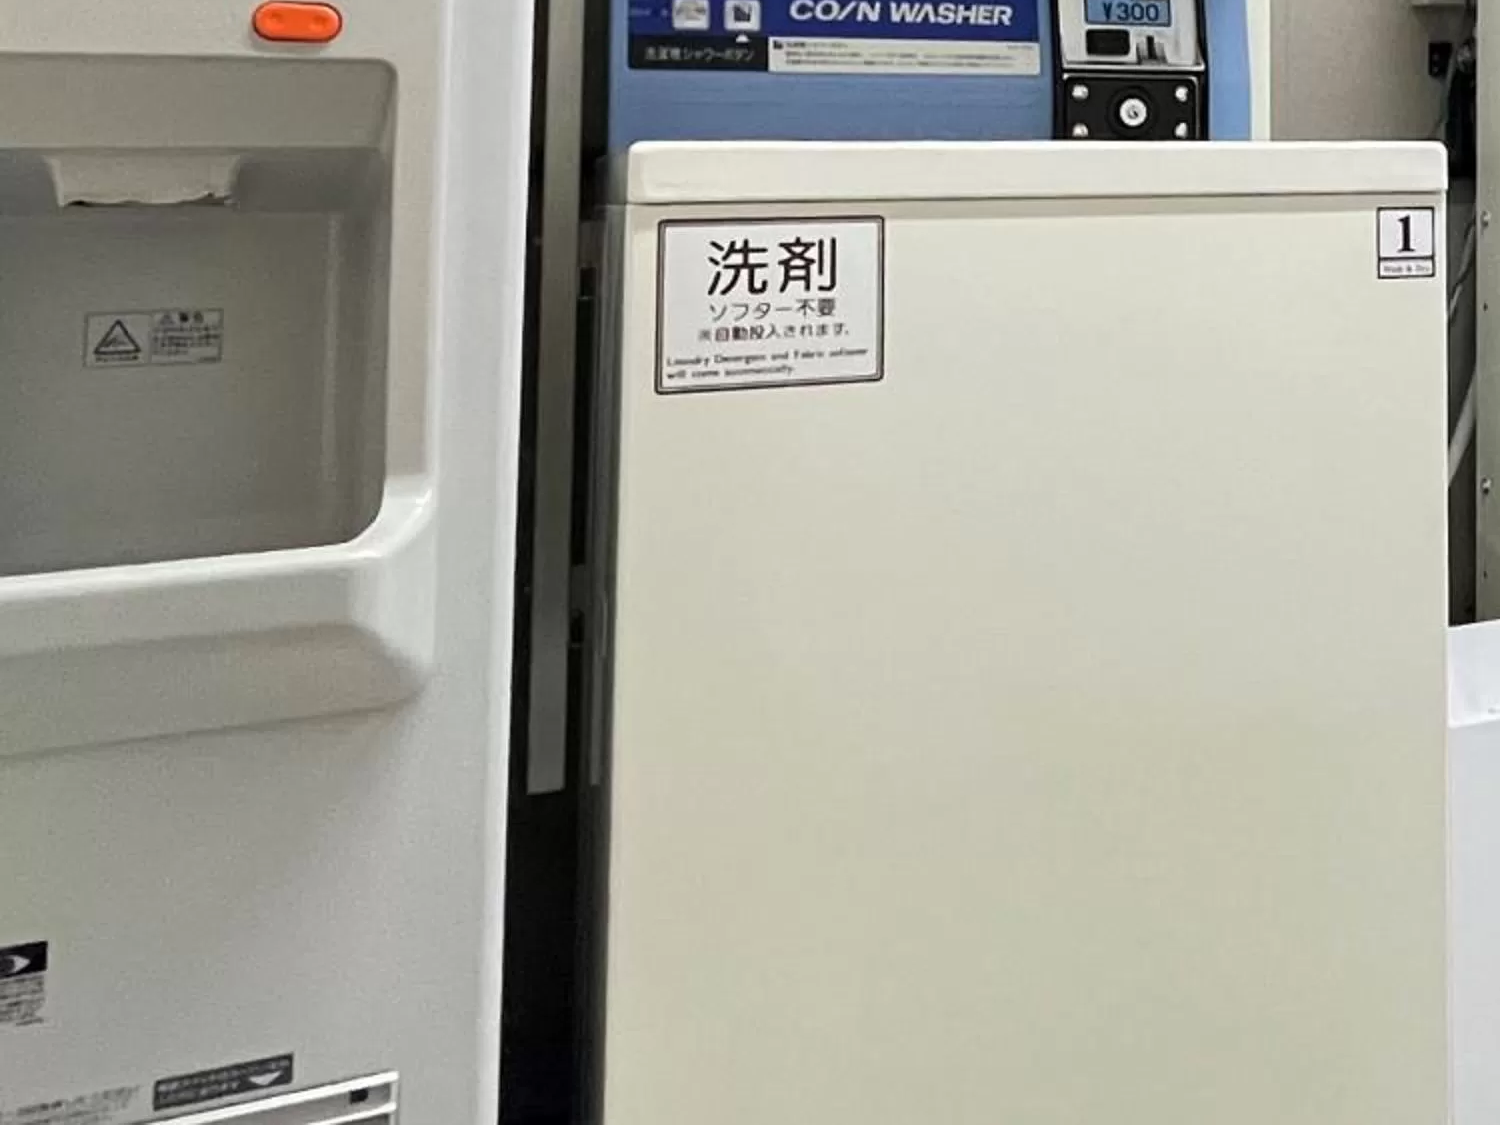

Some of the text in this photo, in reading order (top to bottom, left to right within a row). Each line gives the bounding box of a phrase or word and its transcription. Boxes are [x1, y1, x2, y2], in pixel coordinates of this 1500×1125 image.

[889, 0, 1013, 26] WASHER
[1397, 214, 1416, 253] 1
[707, 236, 837, 296] 洗剤
[709, 298, 837, 322] ソフター不要
